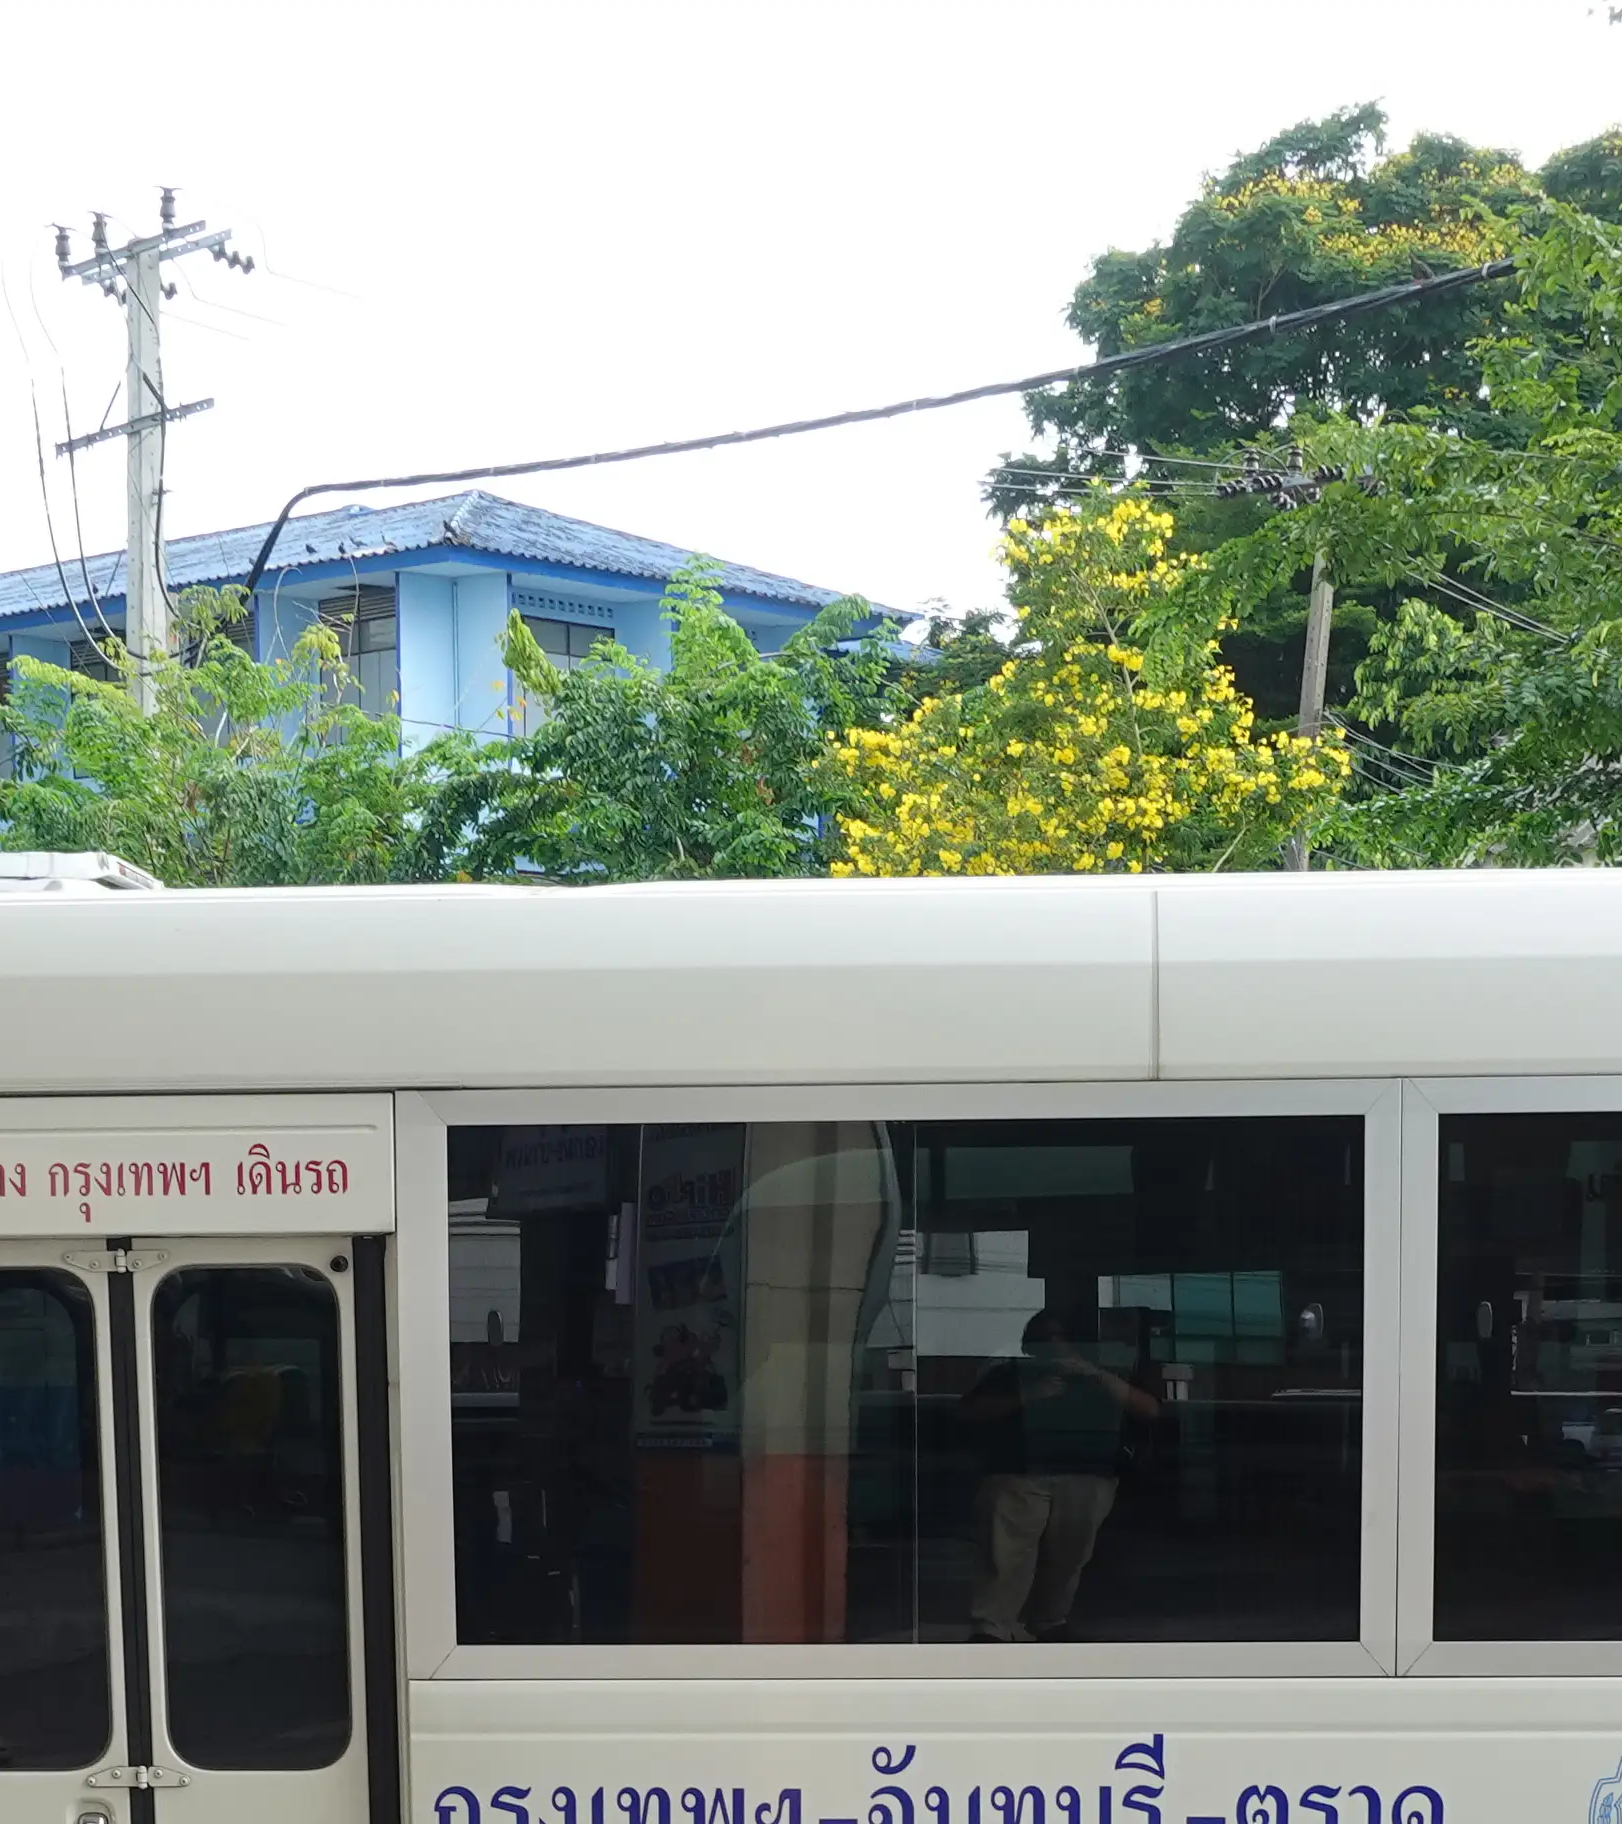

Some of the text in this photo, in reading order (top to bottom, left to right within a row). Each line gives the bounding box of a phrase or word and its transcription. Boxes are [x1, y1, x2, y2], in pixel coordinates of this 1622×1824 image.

[48, 1161, 211, 1224] กรุงเทพฯ
[236, 1142, 349, 1196] เดินรถ
